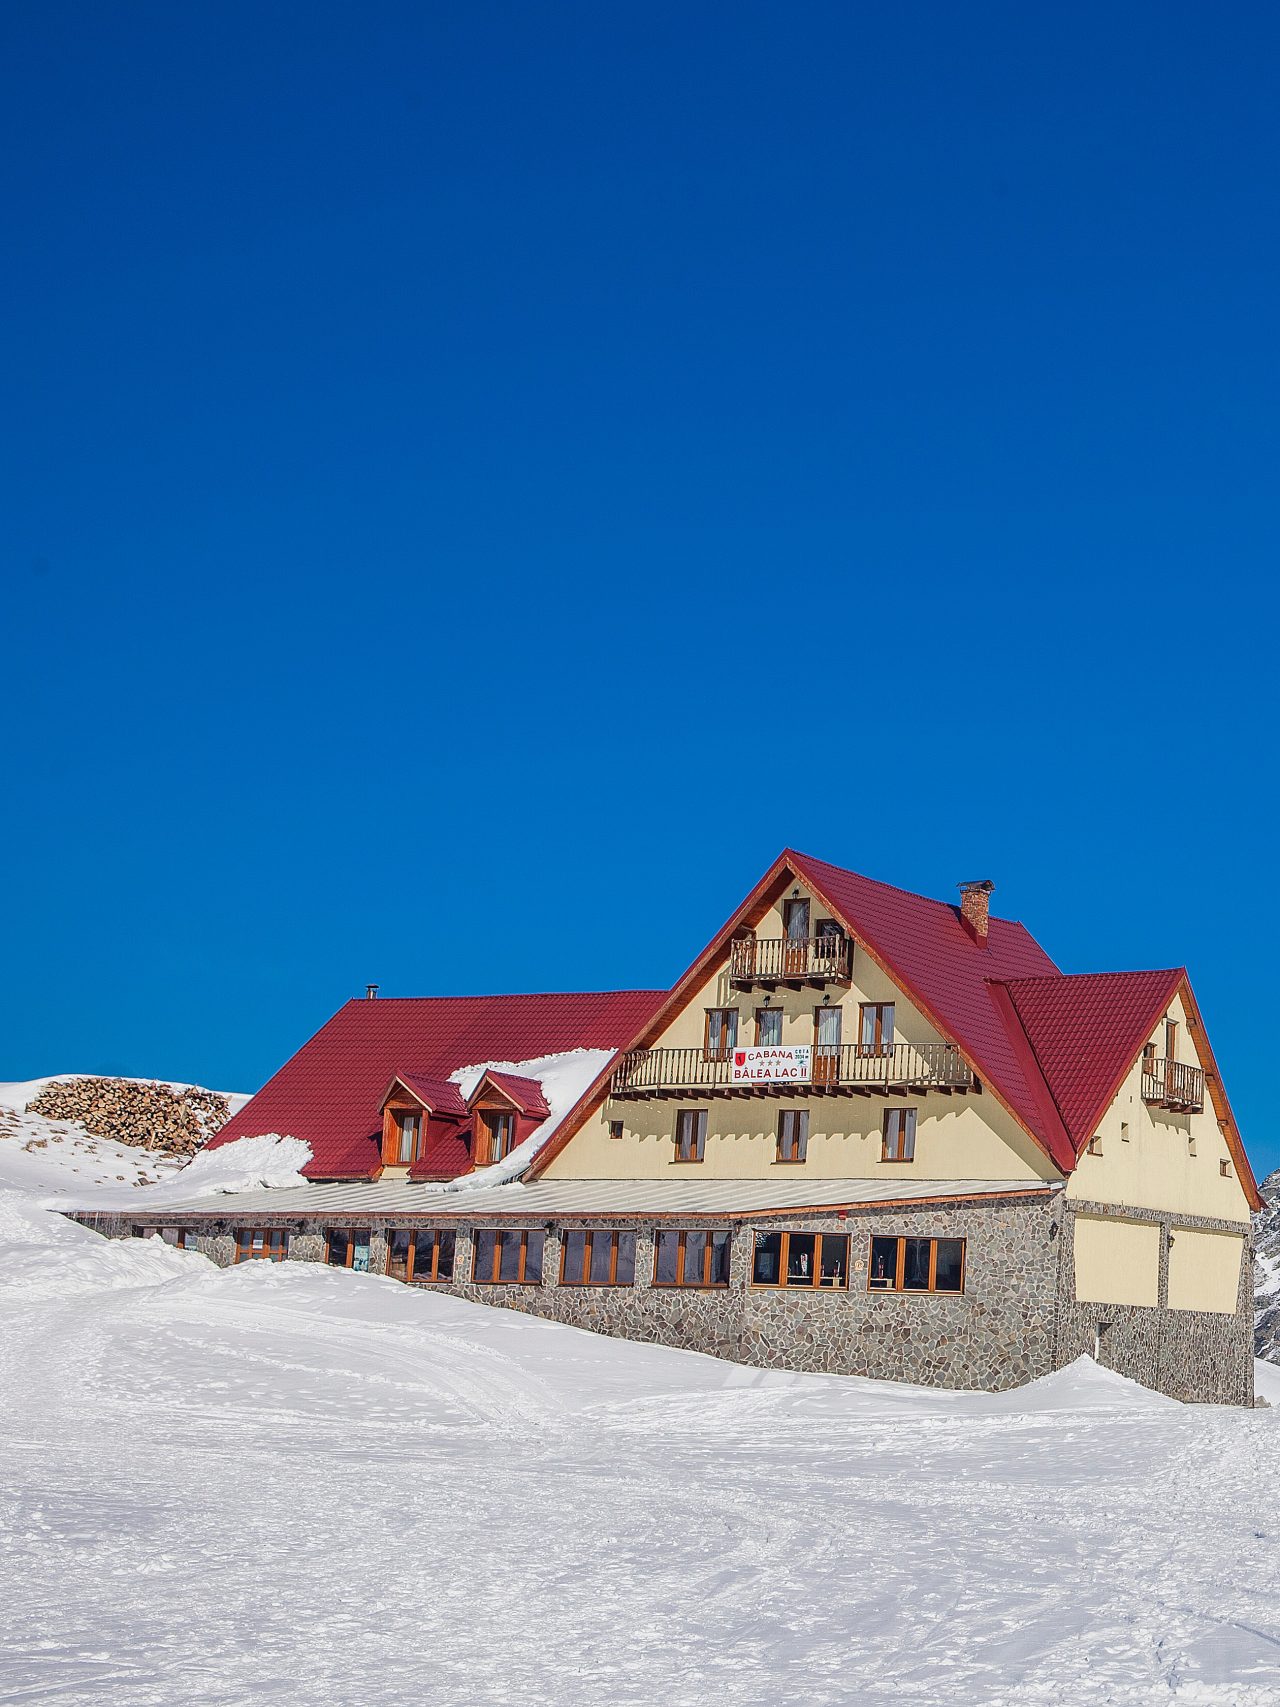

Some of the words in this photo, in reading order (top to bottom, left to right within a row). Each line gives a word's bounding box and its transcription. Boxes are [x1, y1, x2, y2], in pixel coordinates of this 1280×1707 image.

[748, 1050, 793, 1061] CABANA
[734, 1067, 771, 1078] BÂLEA
[775, 1068, 798, 1078] LAC
[801, 1068, 806, 1076] II
